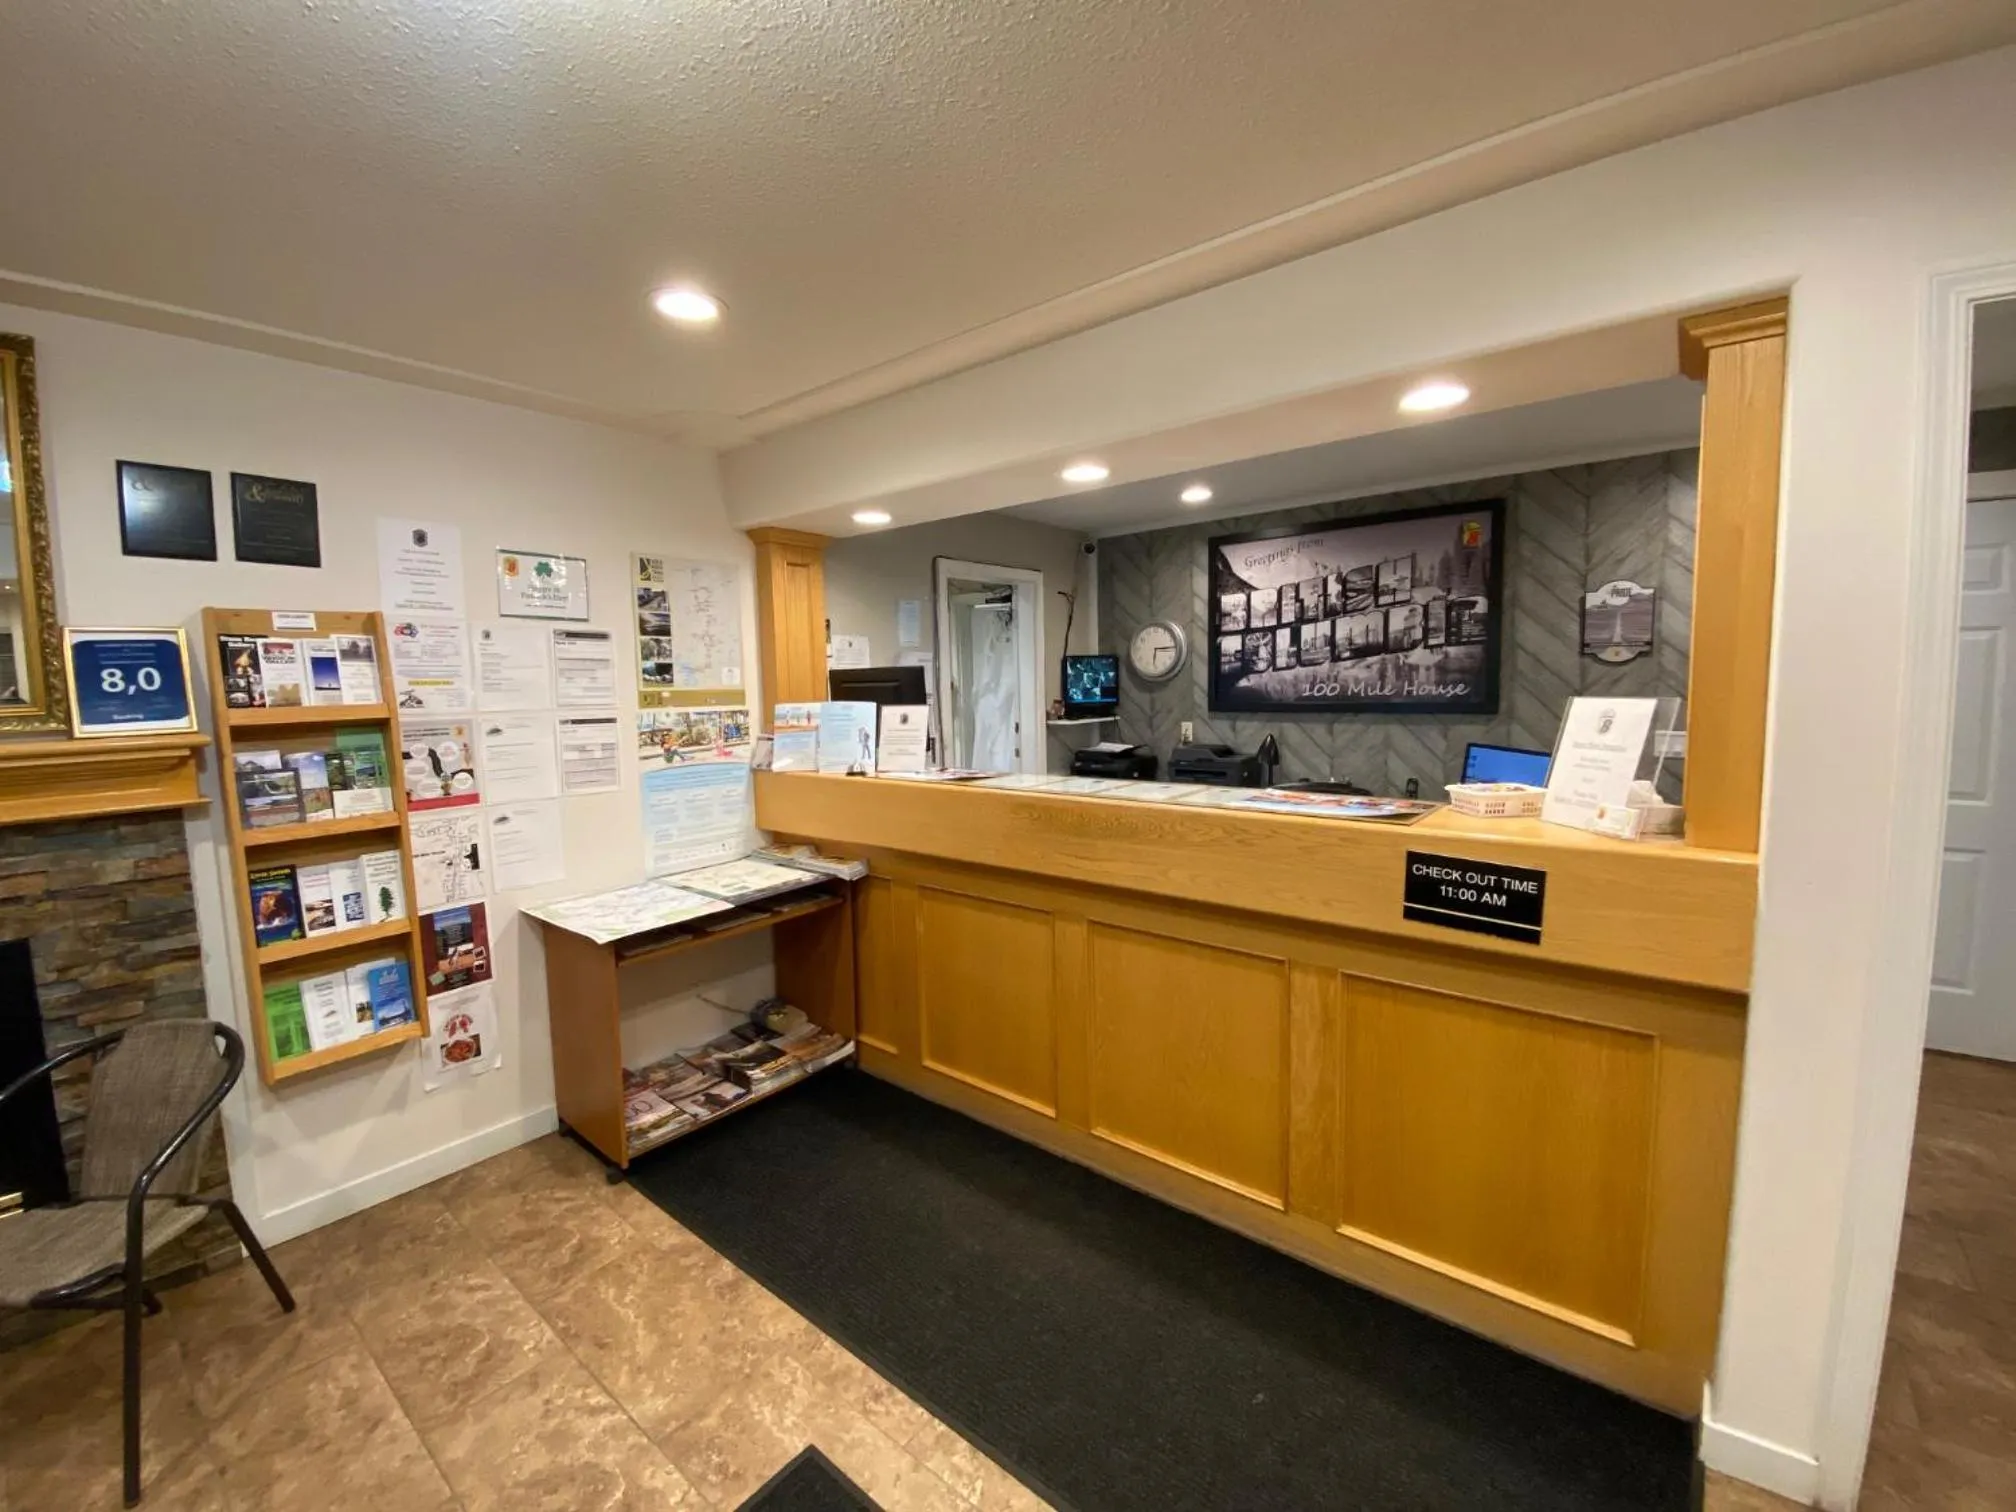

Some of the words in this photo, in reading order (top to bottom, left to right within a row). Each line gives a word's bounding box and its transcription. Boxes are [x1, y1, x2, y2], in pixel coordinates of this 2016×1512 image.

[101, 667, 161, 695] 8,0
[1302, 682, 1340, 697] 100
[1348, 681, 1397, 697] Mile
[1403, 680, 1471, 697] House
[1412, 863, 1462, 881] CHECK
[1466, 872, 1498, 887] OUT
[1501, 876, 1538, 894] TIME
[1440, 885, 1477, 902] 11:00
[1481, 893, 1507, 907] AM
